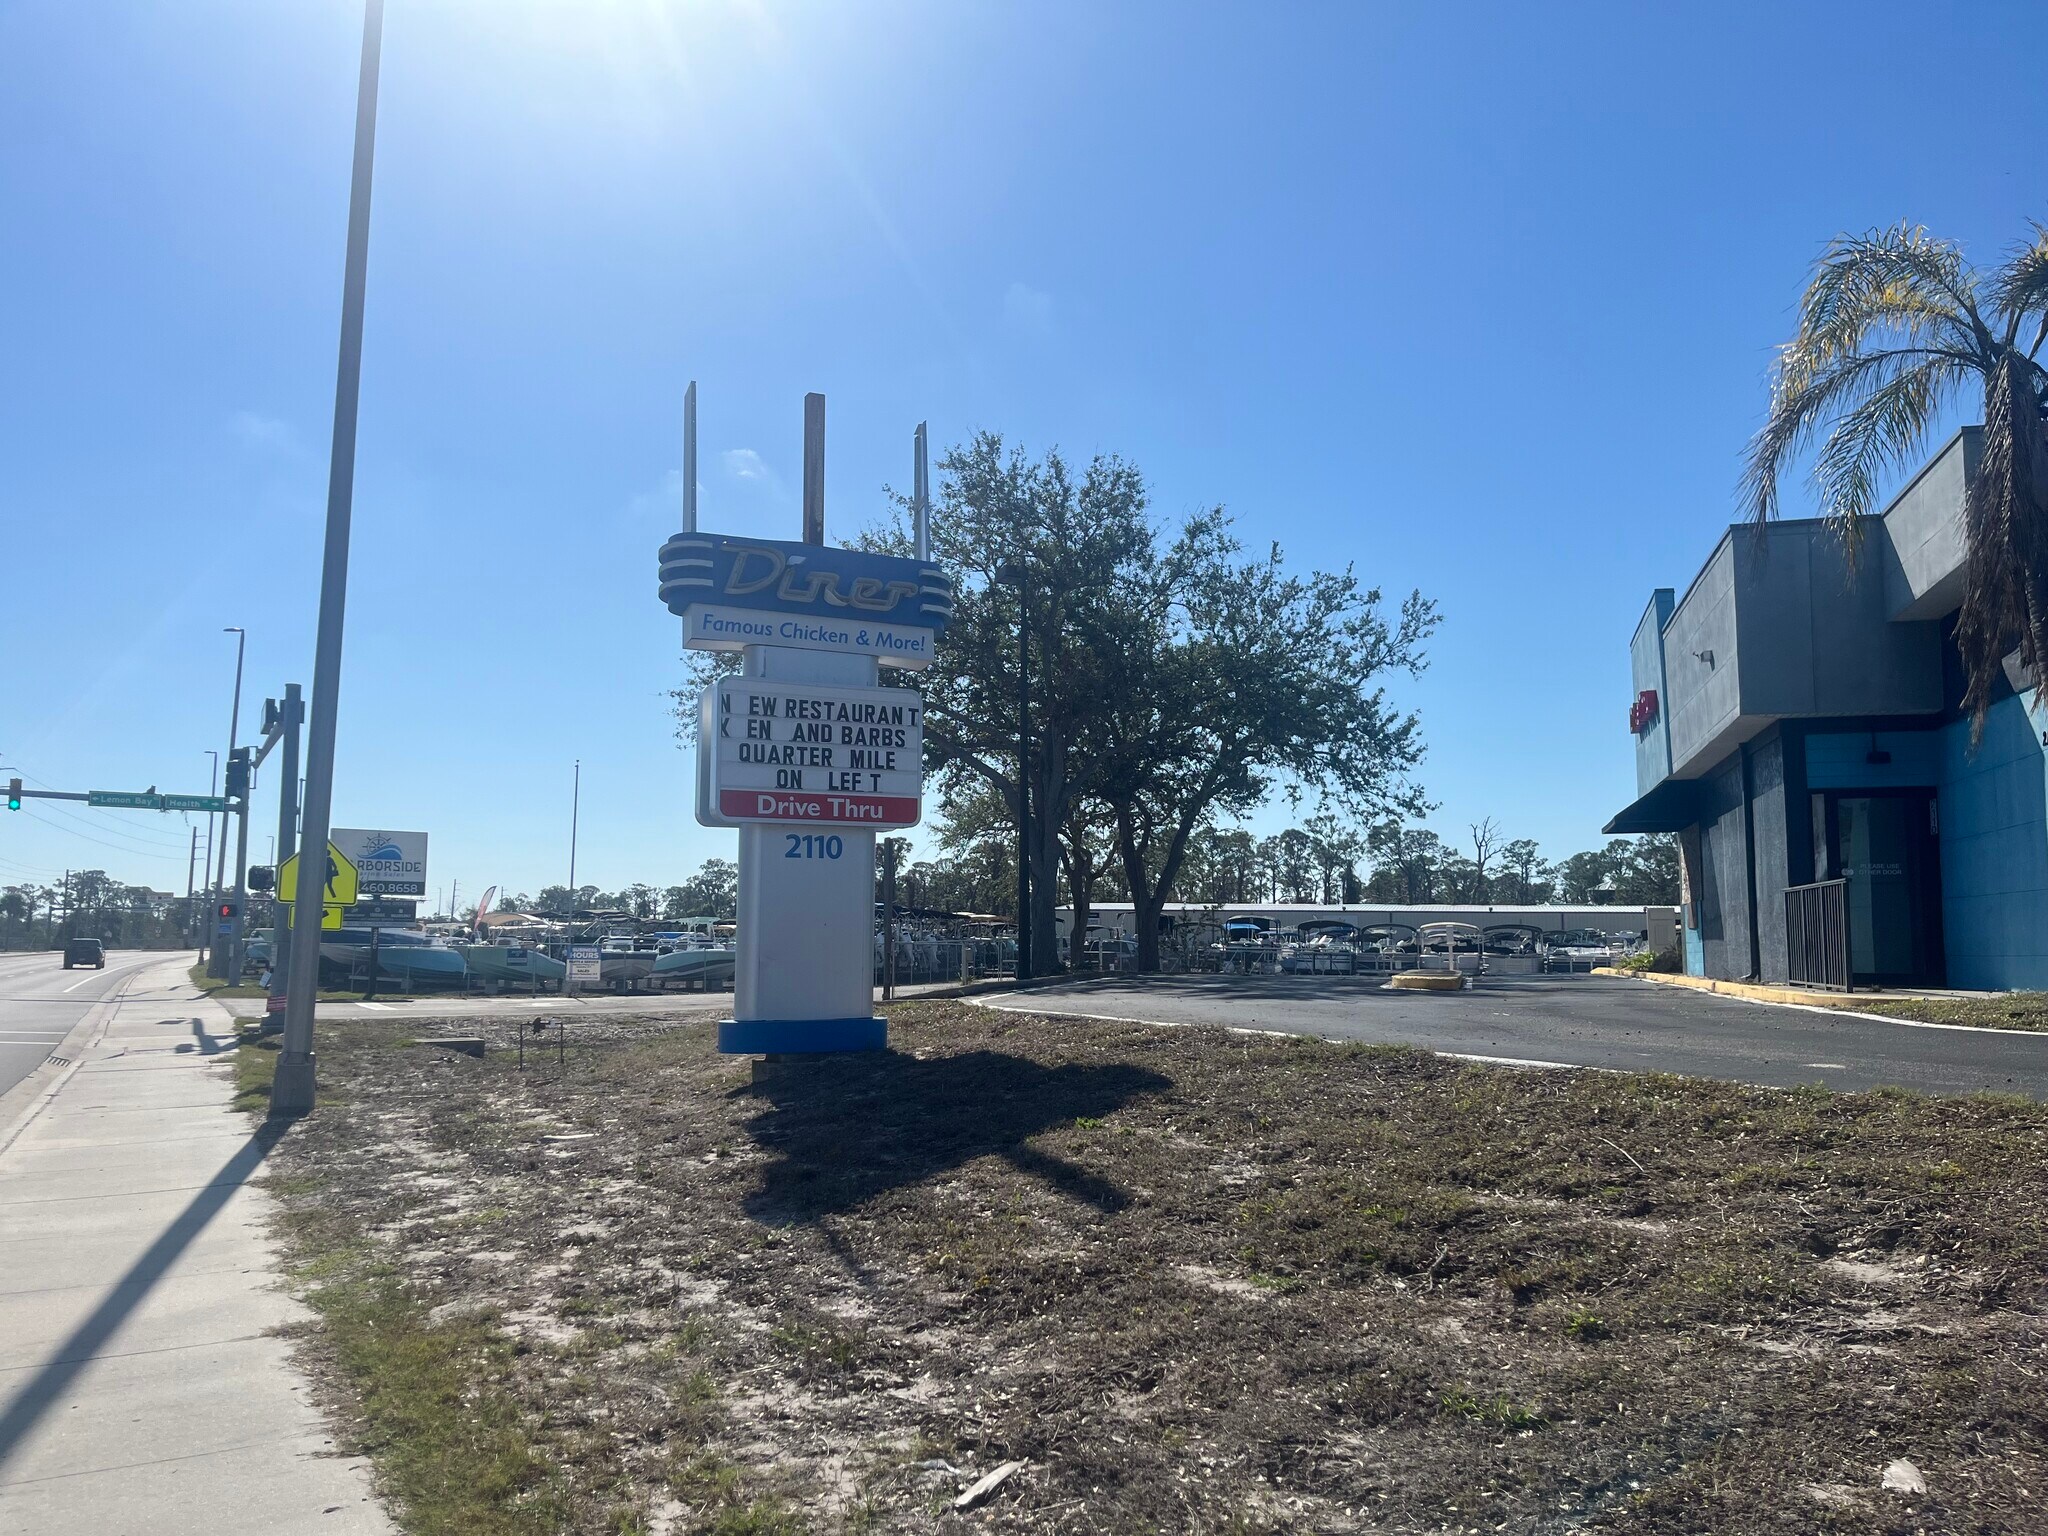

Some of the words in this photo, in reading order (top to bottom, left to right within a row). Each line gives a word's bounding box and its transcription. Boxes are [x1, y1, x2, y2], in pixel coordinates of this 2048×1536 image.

[720, 543, 918, 611] Diner
[702, 614, 772, 637] Famous
[780, 622, 848, 643] Chicken
[856, 631, 870, 646] &
[875, 632, 925, 651] More!
[785, 698, 919, 727] RESTAURANT
[793, 723, 832, 743] AND
[841, 726, 906, 748] BARBS
[739, 742, 833, 767] QUARTER
[851, 749, 896, 770] MILE
[776, 769, 802, 789] ON
[100, 795, 131, 804] Lemon
[134, 797, 152, 806] Bay
[169, 799, 201, 807] Health
[757, 795, 820, 816] Drive
[827, 797, 883, 819] Thru
[785, 833, 843, 860] 2110
[350, 860, 421, 872] RBORSIDE
